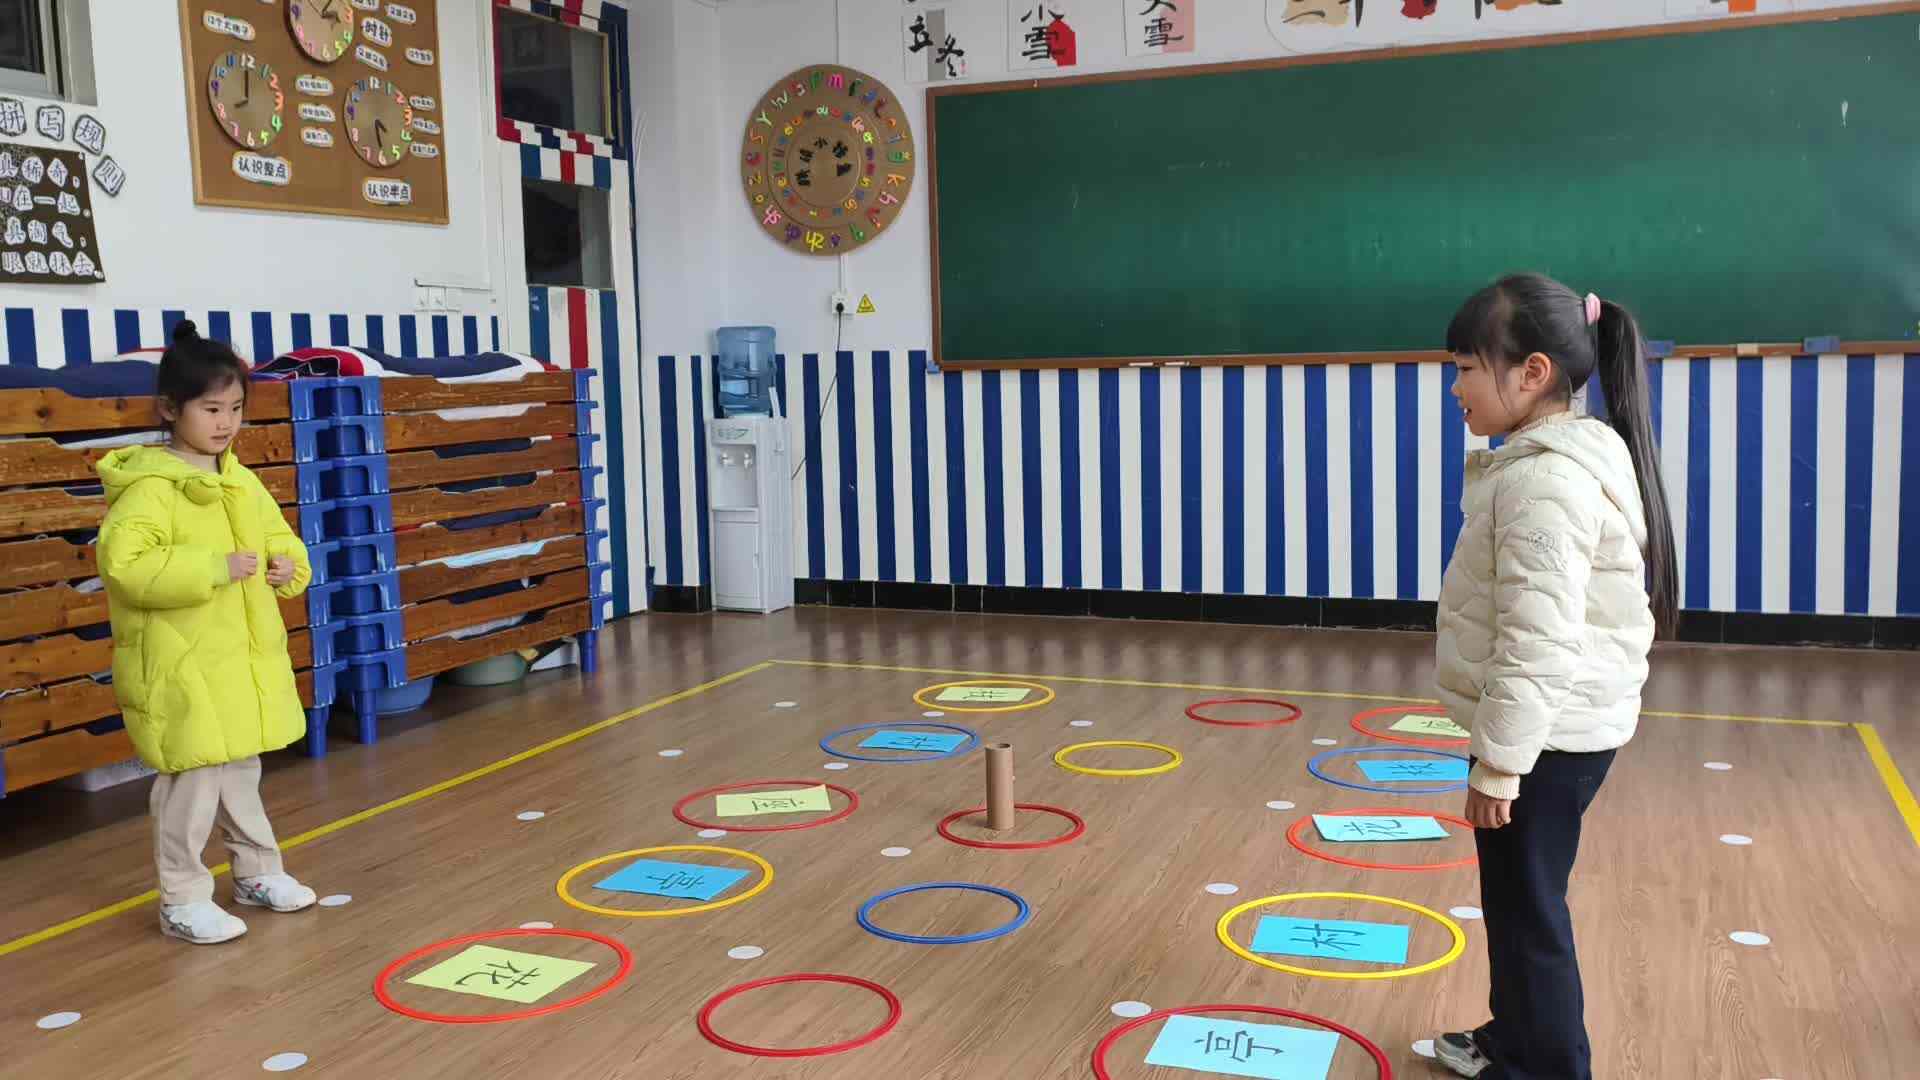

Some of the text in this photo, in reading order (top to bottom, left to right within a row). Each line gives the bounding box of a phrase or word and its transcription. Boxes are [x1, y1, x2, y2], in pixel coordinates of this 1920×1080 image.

[365, 20, 389, 42] 时针
[1020, 4, 1065, 61] 小雪
[908, 15, 965, 77] 立冬
[0, 102, 122, 191] 拼写规则
[238, 157, 286, 178] 认识整点
[368, 183, 409, 201] 认识半点
[1386, 762, 1445, 776] 枝
[752, 797, 805, 811] 座
[1344, 819, 1408, 837] 花
[648, 870, 706, 893] 亭
[1290, 922, 1367, 952] 村
[456, 960, 544, 991] 花
[1194, 1029, 1285, 1063] 亭
